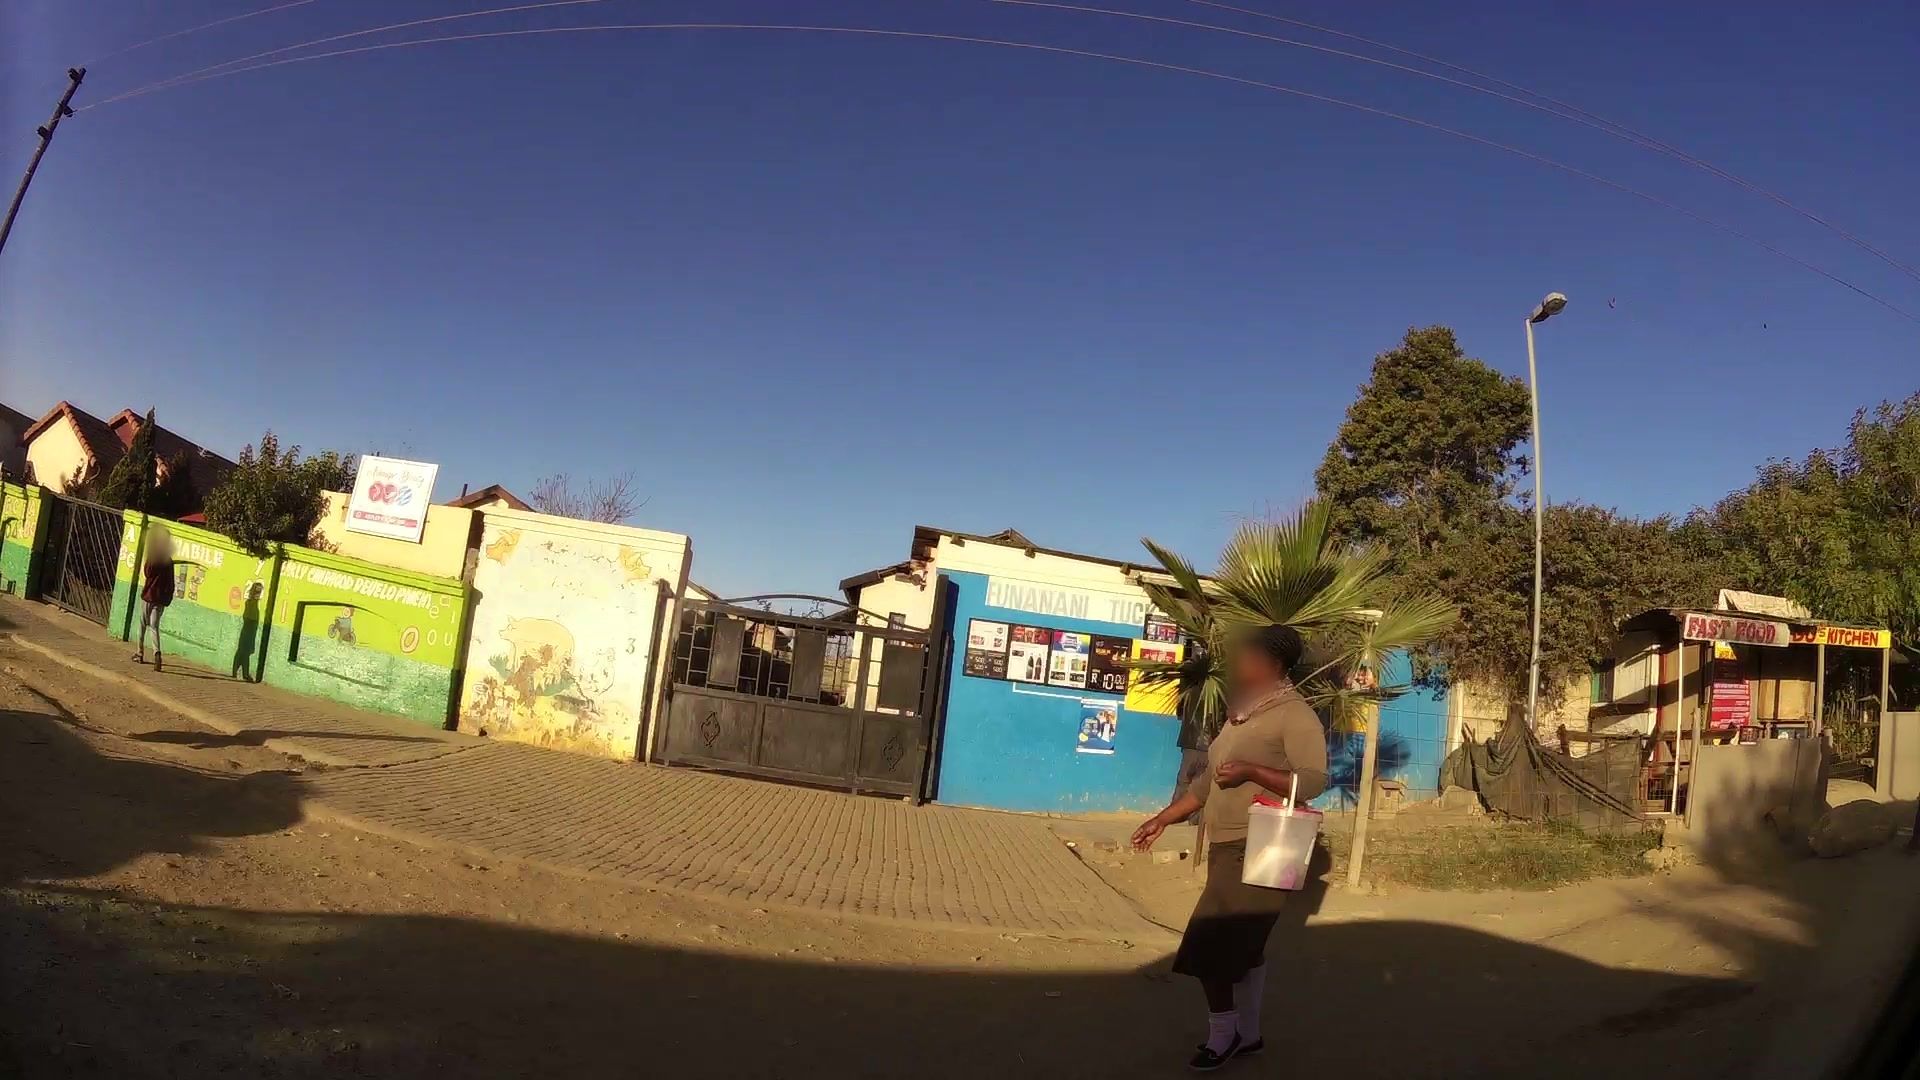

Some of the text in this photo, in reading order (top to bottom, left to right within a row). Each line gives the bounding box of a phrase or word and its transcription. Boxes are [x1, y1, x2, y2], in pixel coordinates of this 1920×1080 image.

[988, 581, 1090, 618] FUNANANI
[1687, 616, 1776, 644] FAST FOOD
[1827, 627, 1879, 647] KITCHEN
